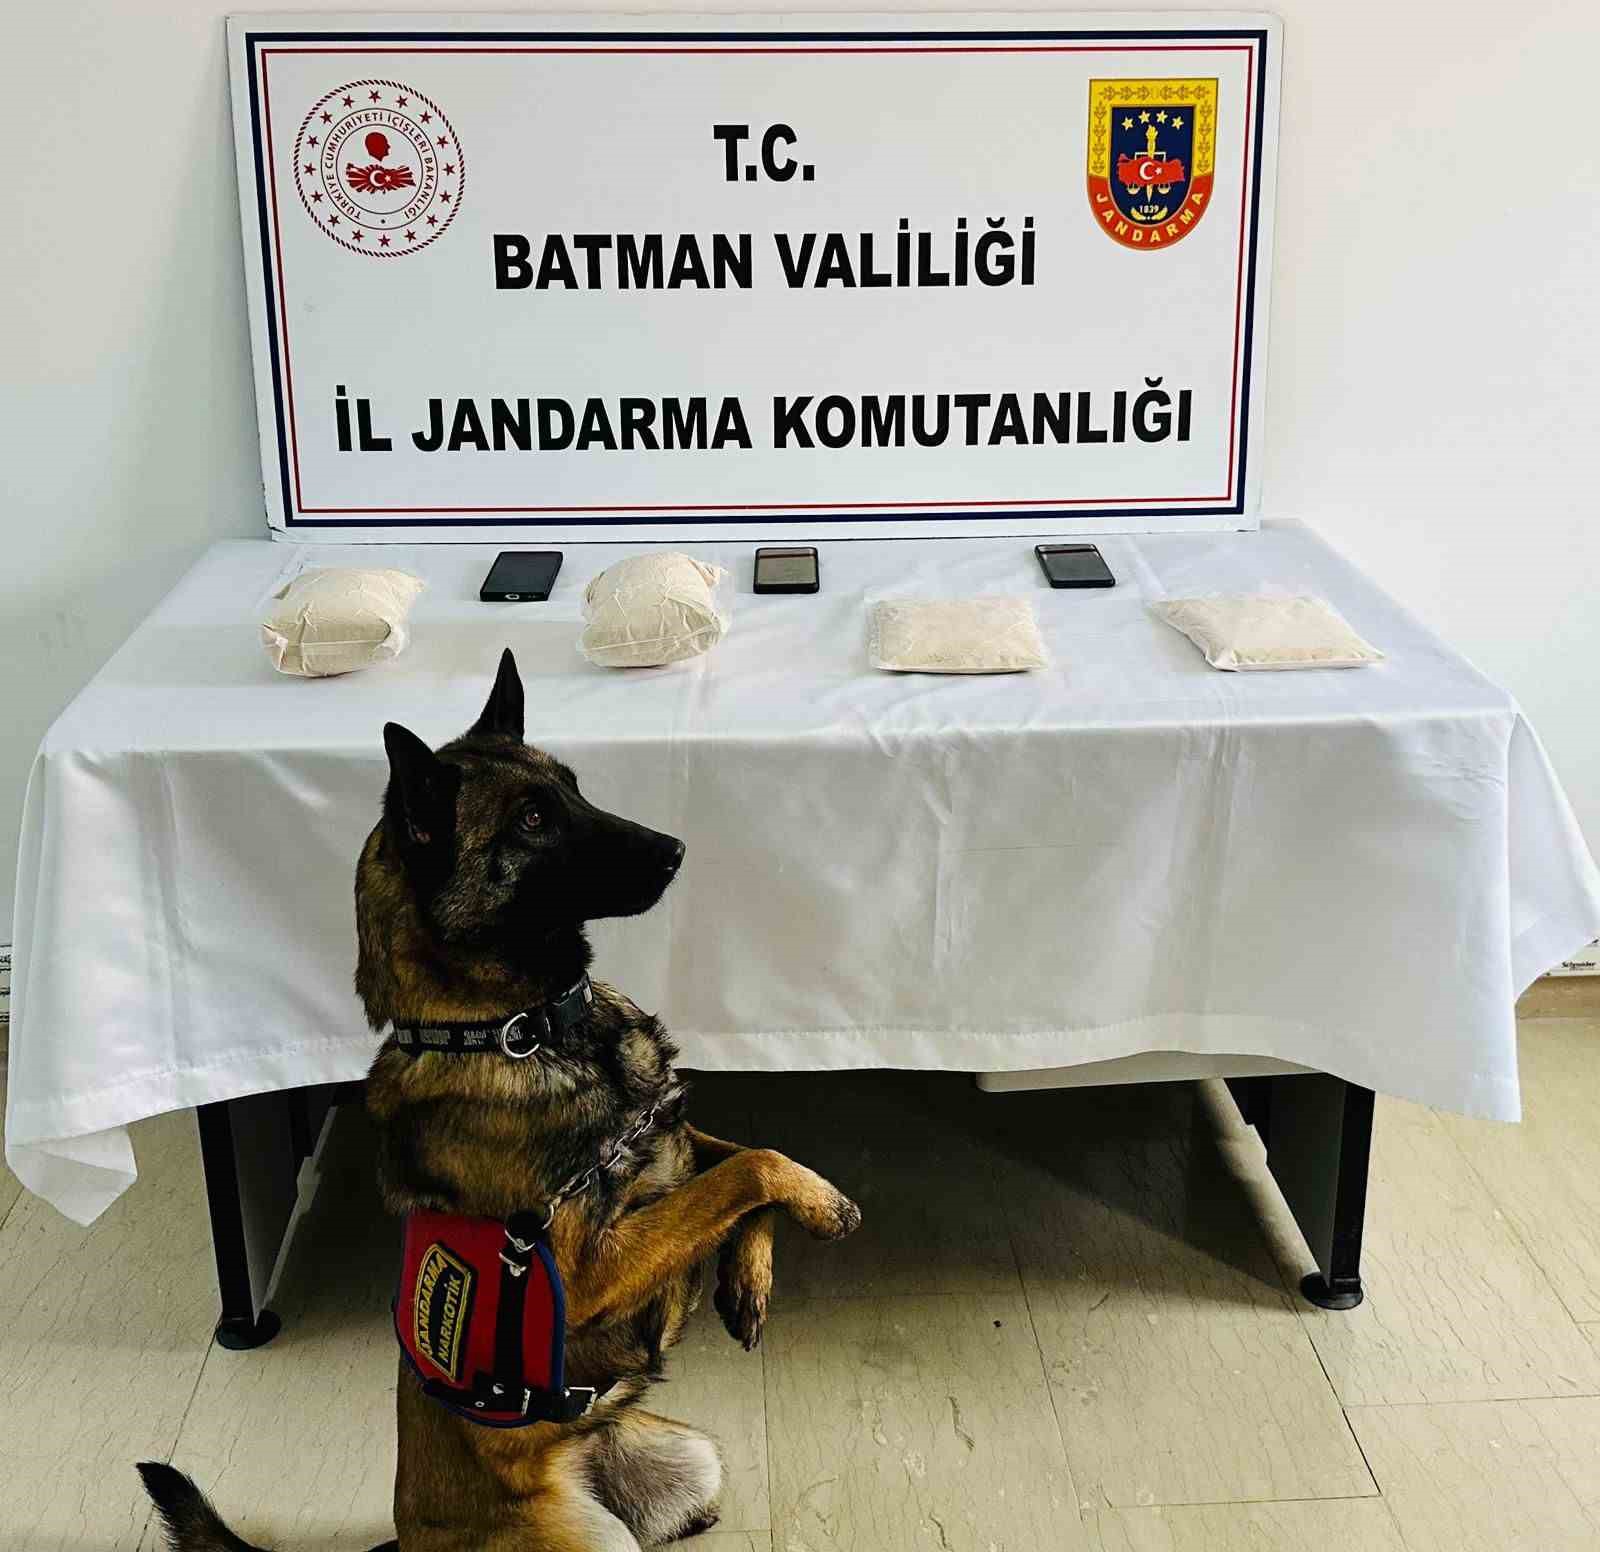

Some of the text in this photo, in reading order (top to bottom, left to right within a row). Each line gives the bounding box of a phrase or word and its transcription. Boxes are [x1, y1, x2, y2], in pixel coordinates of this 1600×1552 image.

[325, 112, 383, 169] CUMHURİYETİ
[387, 113, 430, 153] İÇİŞLERİ
[714, 123, 815, 182] T.C.
[404, 157, 434, 219] BAKANLIĞI
[1096, 192, 1204, 243] JANDARMA
[494, 217, 1036, 289] BATMAN VALİLİĞİ
[335, 376, 1193, 452] İL JANDARMA KOMUTANLIĞI
[418, 1252, 448, 1358] JANDARMA
[438, 1274, 462, 1363] NARKOTİK
